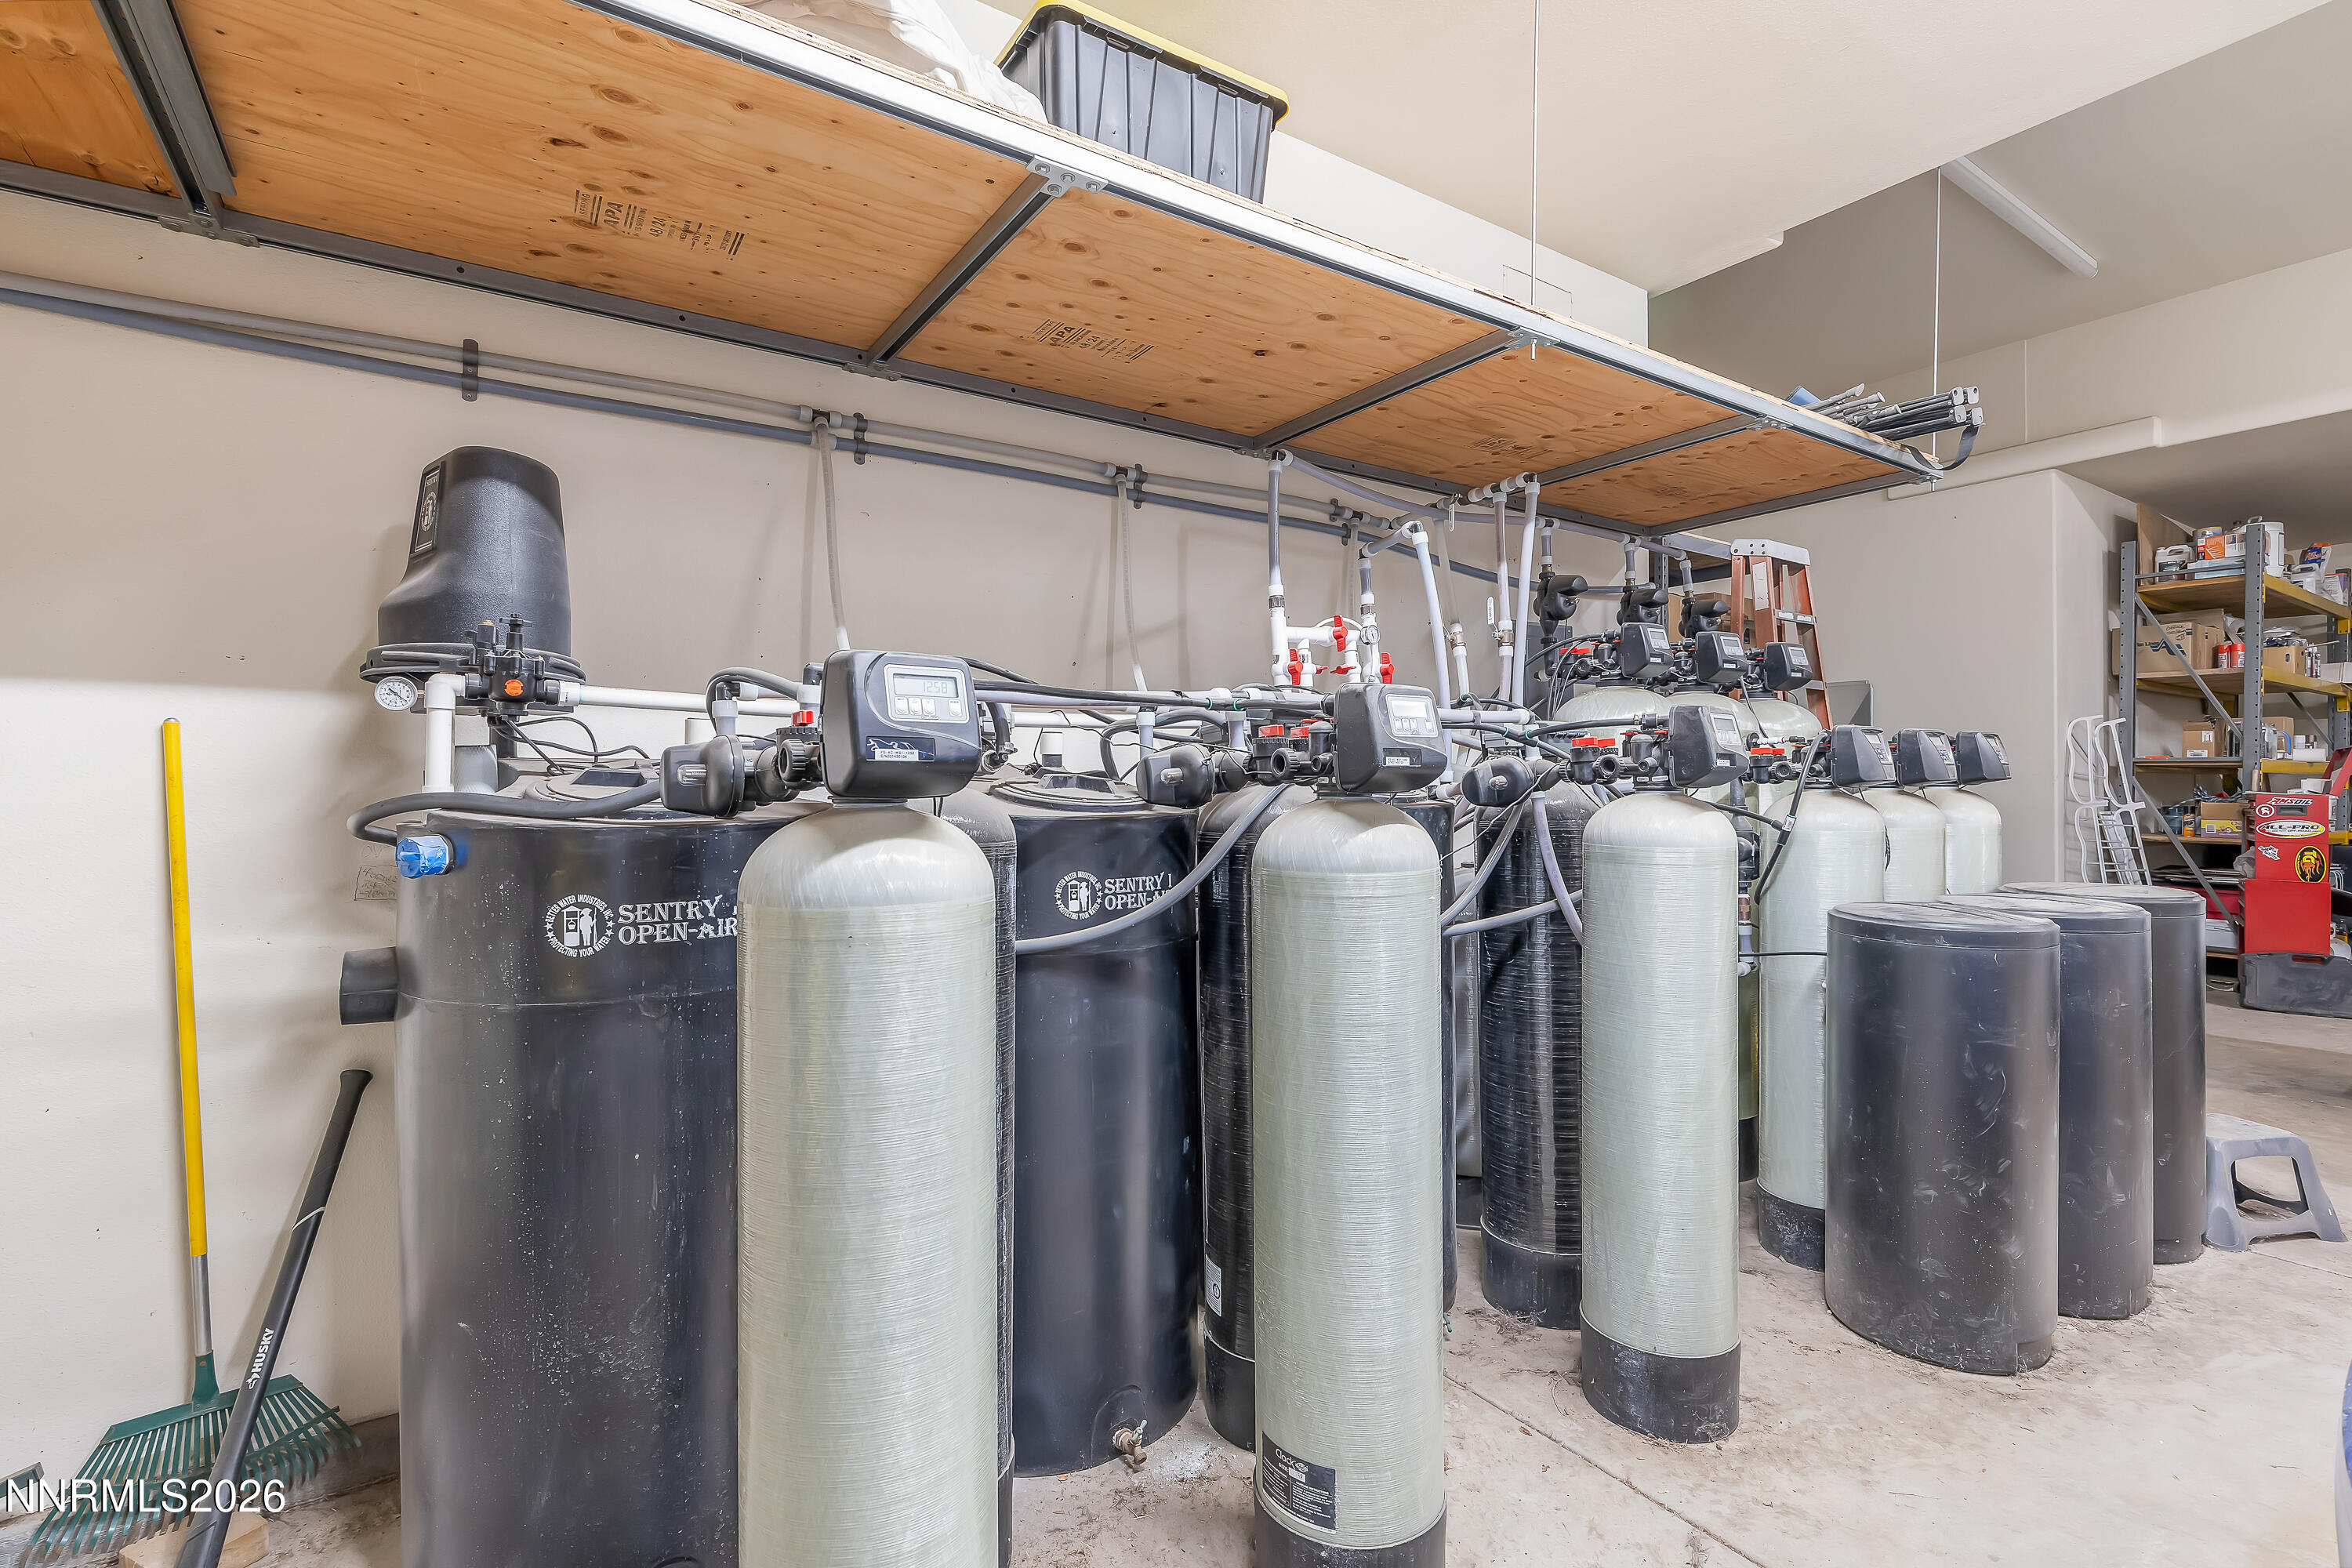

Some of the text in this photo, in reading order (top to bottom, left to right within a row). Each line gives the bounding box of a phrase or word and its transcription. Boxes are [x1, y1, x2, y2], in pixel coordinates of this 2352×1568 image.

[603, 201, 624, 227] APA
[649, 216, 666, 238] 48/24
[1049, 325, 1076, 344] APA
[1079, 336, 1101, 349] 48/24
[1104, 871, 1165, 894] SENTRY
[545, 904, 562, 923] BETTER
[557, 895, 577, 909] WATER
[618, 895, 723, 924] SENTRY
[618, 917, 737, 946] OPEN-AIR
[547, 935, 612, 957] PROTECTING YOUR WATER
[251, 1327, 274, 1373] HUSKY
[1276, 1448, 1295, 1471] Clack
